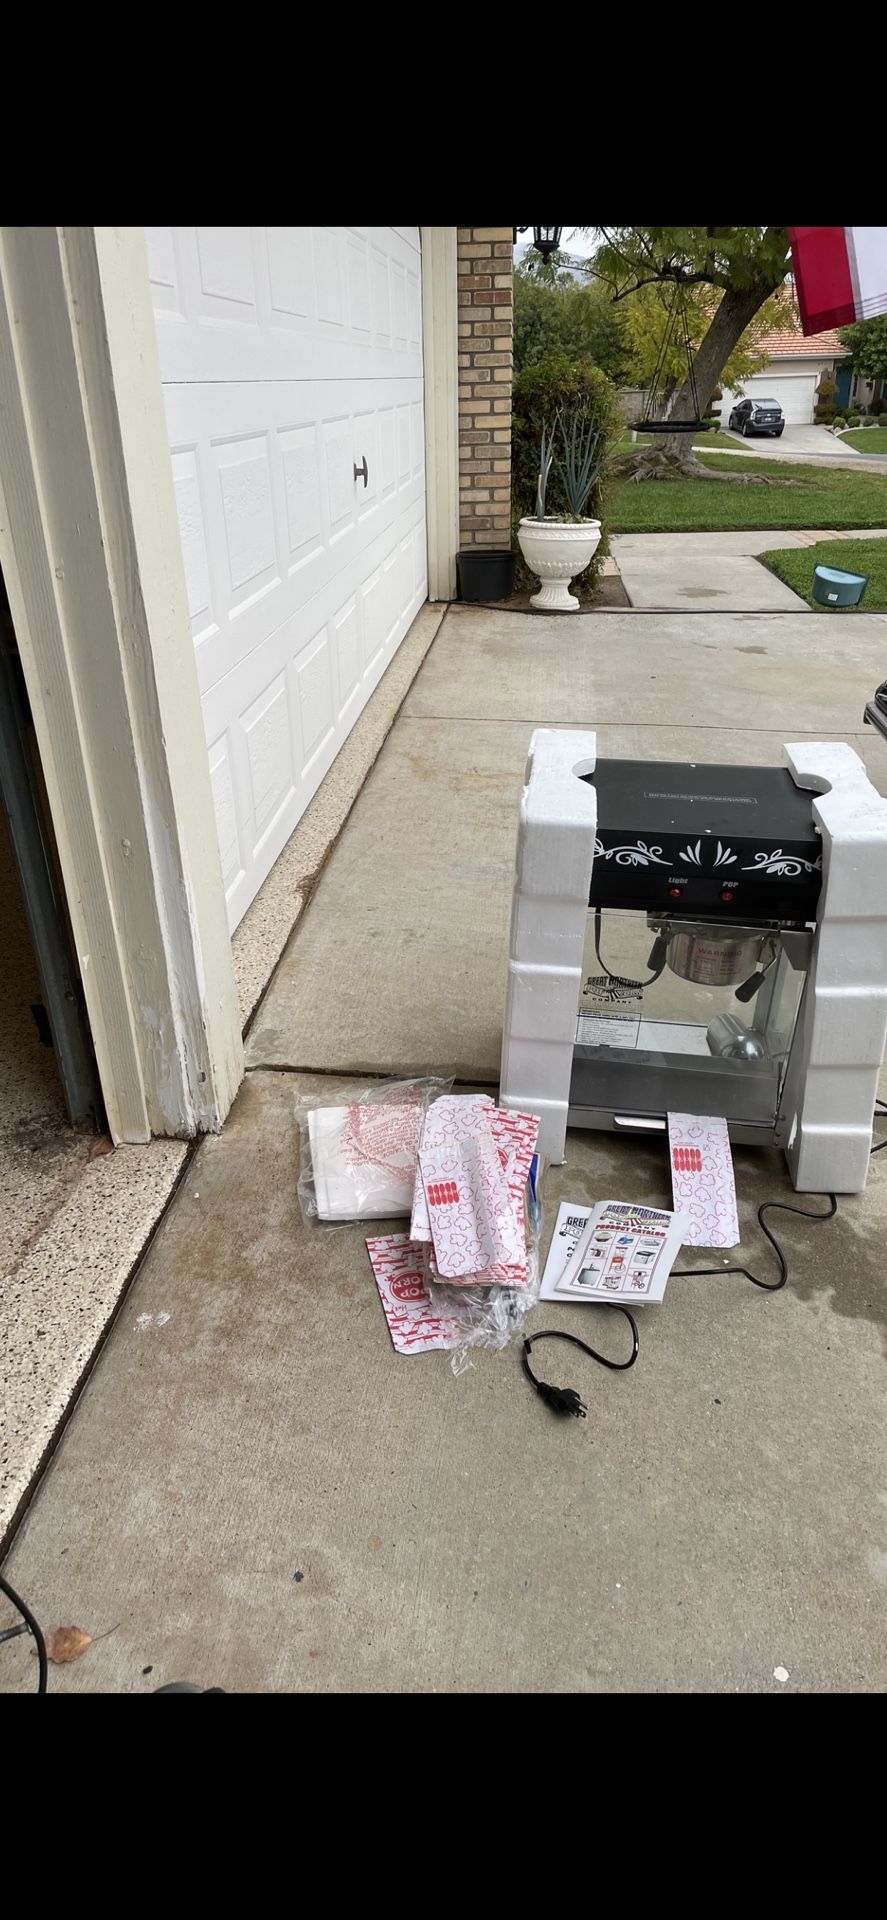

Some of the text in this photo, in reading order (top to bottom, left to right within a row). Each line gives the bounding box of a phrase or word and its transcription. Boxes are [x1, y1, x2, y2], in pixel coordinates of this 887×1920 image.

[697, 947, 742, 957] WARNING
[587, 976, 608, 987] GREAT
[607, 1205, 631, 1215] GREAT
[595, 1224, 666, 1237] PRODUCT CATALOG
